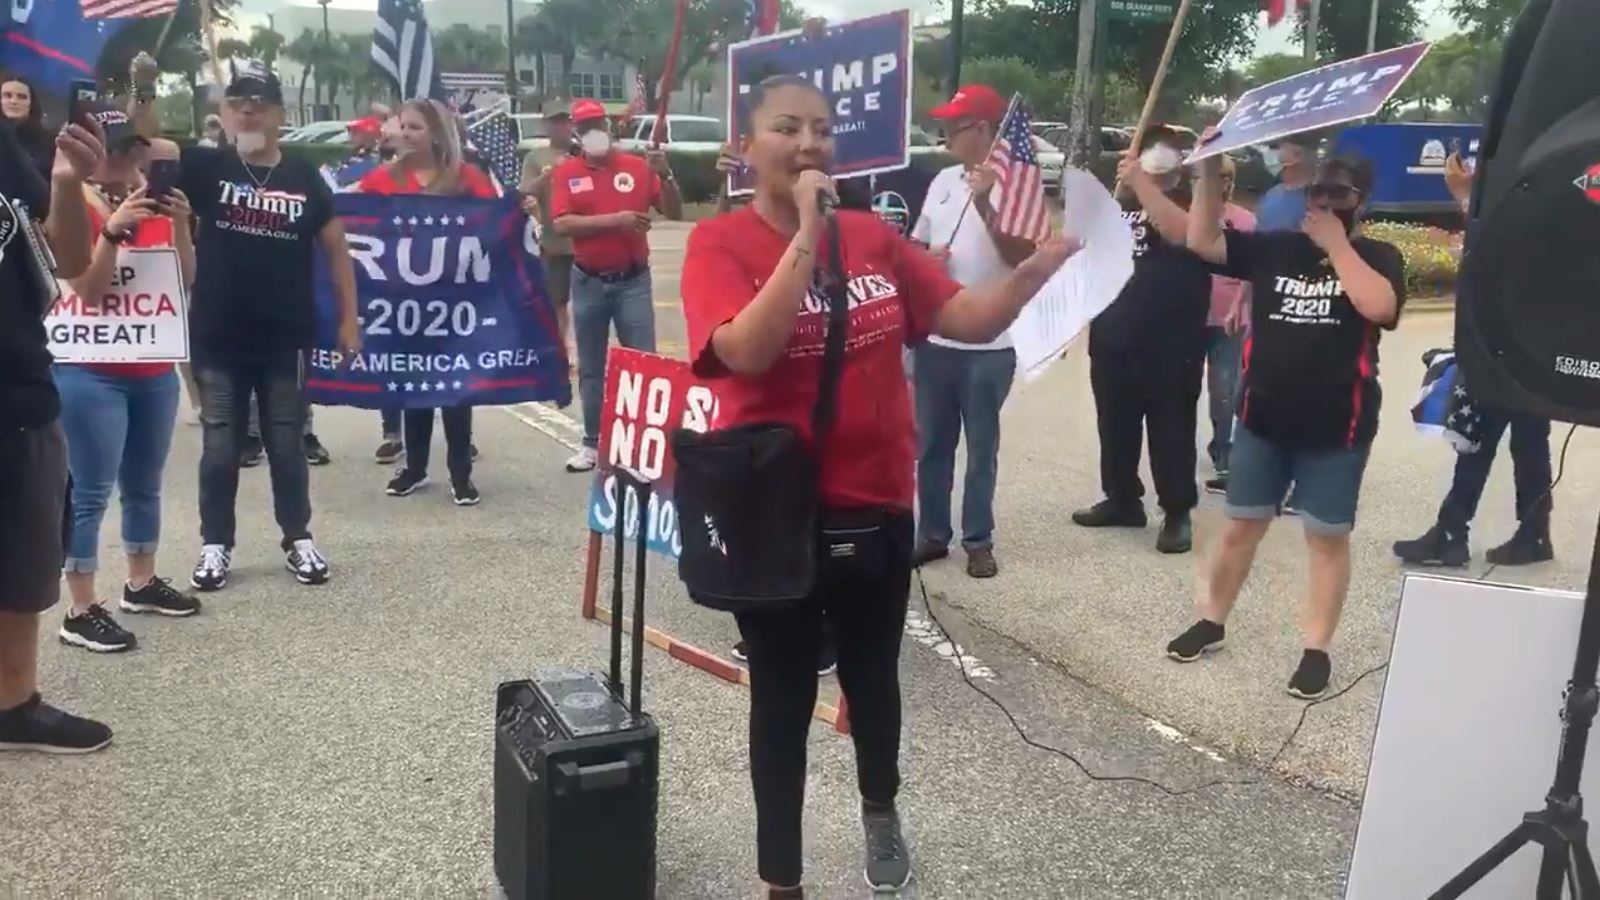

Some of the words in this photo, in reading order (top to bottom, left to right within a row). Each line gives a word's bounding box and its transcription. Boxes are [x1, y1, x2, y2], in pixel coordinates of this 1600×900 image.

[218, 180, 304, 223] Trump
[232, 206, 281, 230] 2020
[231, 224, 273, 237] AMERICA
[50, 293, 177, 317] MERICA
[1281, 297, 1331, 316] 2020
[51, 324, 156, 344] GREAT!
[350, 352, 470, 372] AMERICA
[478, 349, 540, 369] GREA
[615, 370, 671, 427] NO
[609, 418, 665, 480] NO
